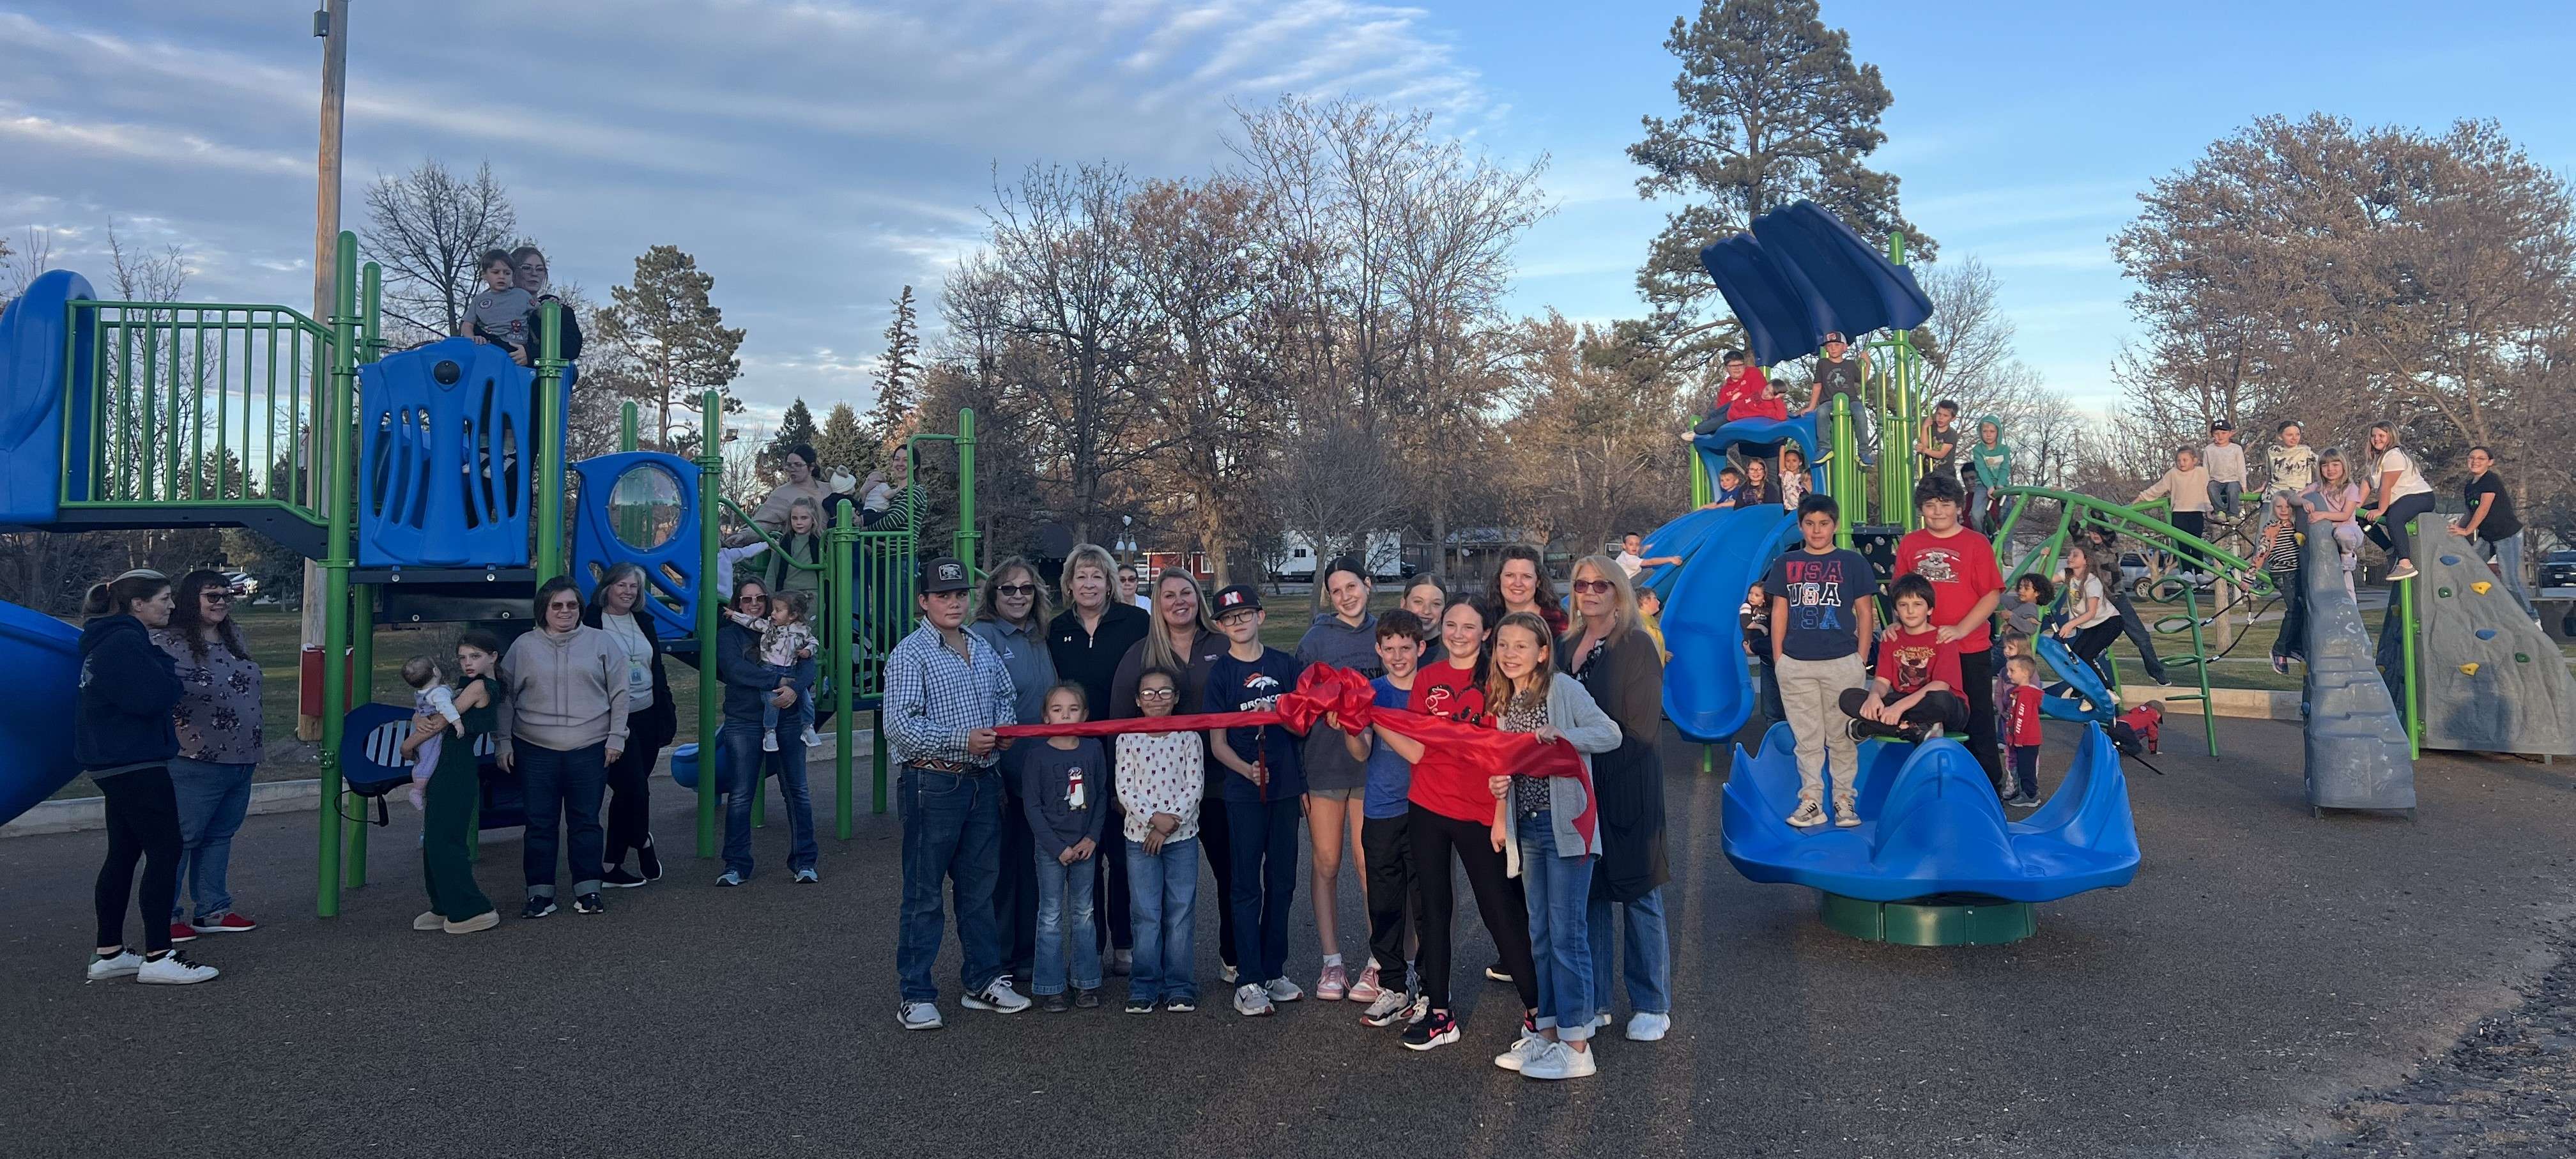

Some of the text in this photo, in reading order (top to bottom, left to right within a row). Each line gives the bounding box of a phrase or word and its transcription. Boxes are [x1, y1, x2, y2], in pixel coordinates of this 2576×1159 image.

[1786, 561, 1843, 583] USA
[1224, 590, 1239, 606] N
[1787, 582, 1841, 606] USA
[1788, 606, 1841, 629] USA
[1240, 694, 1284, 711] BRONCO
